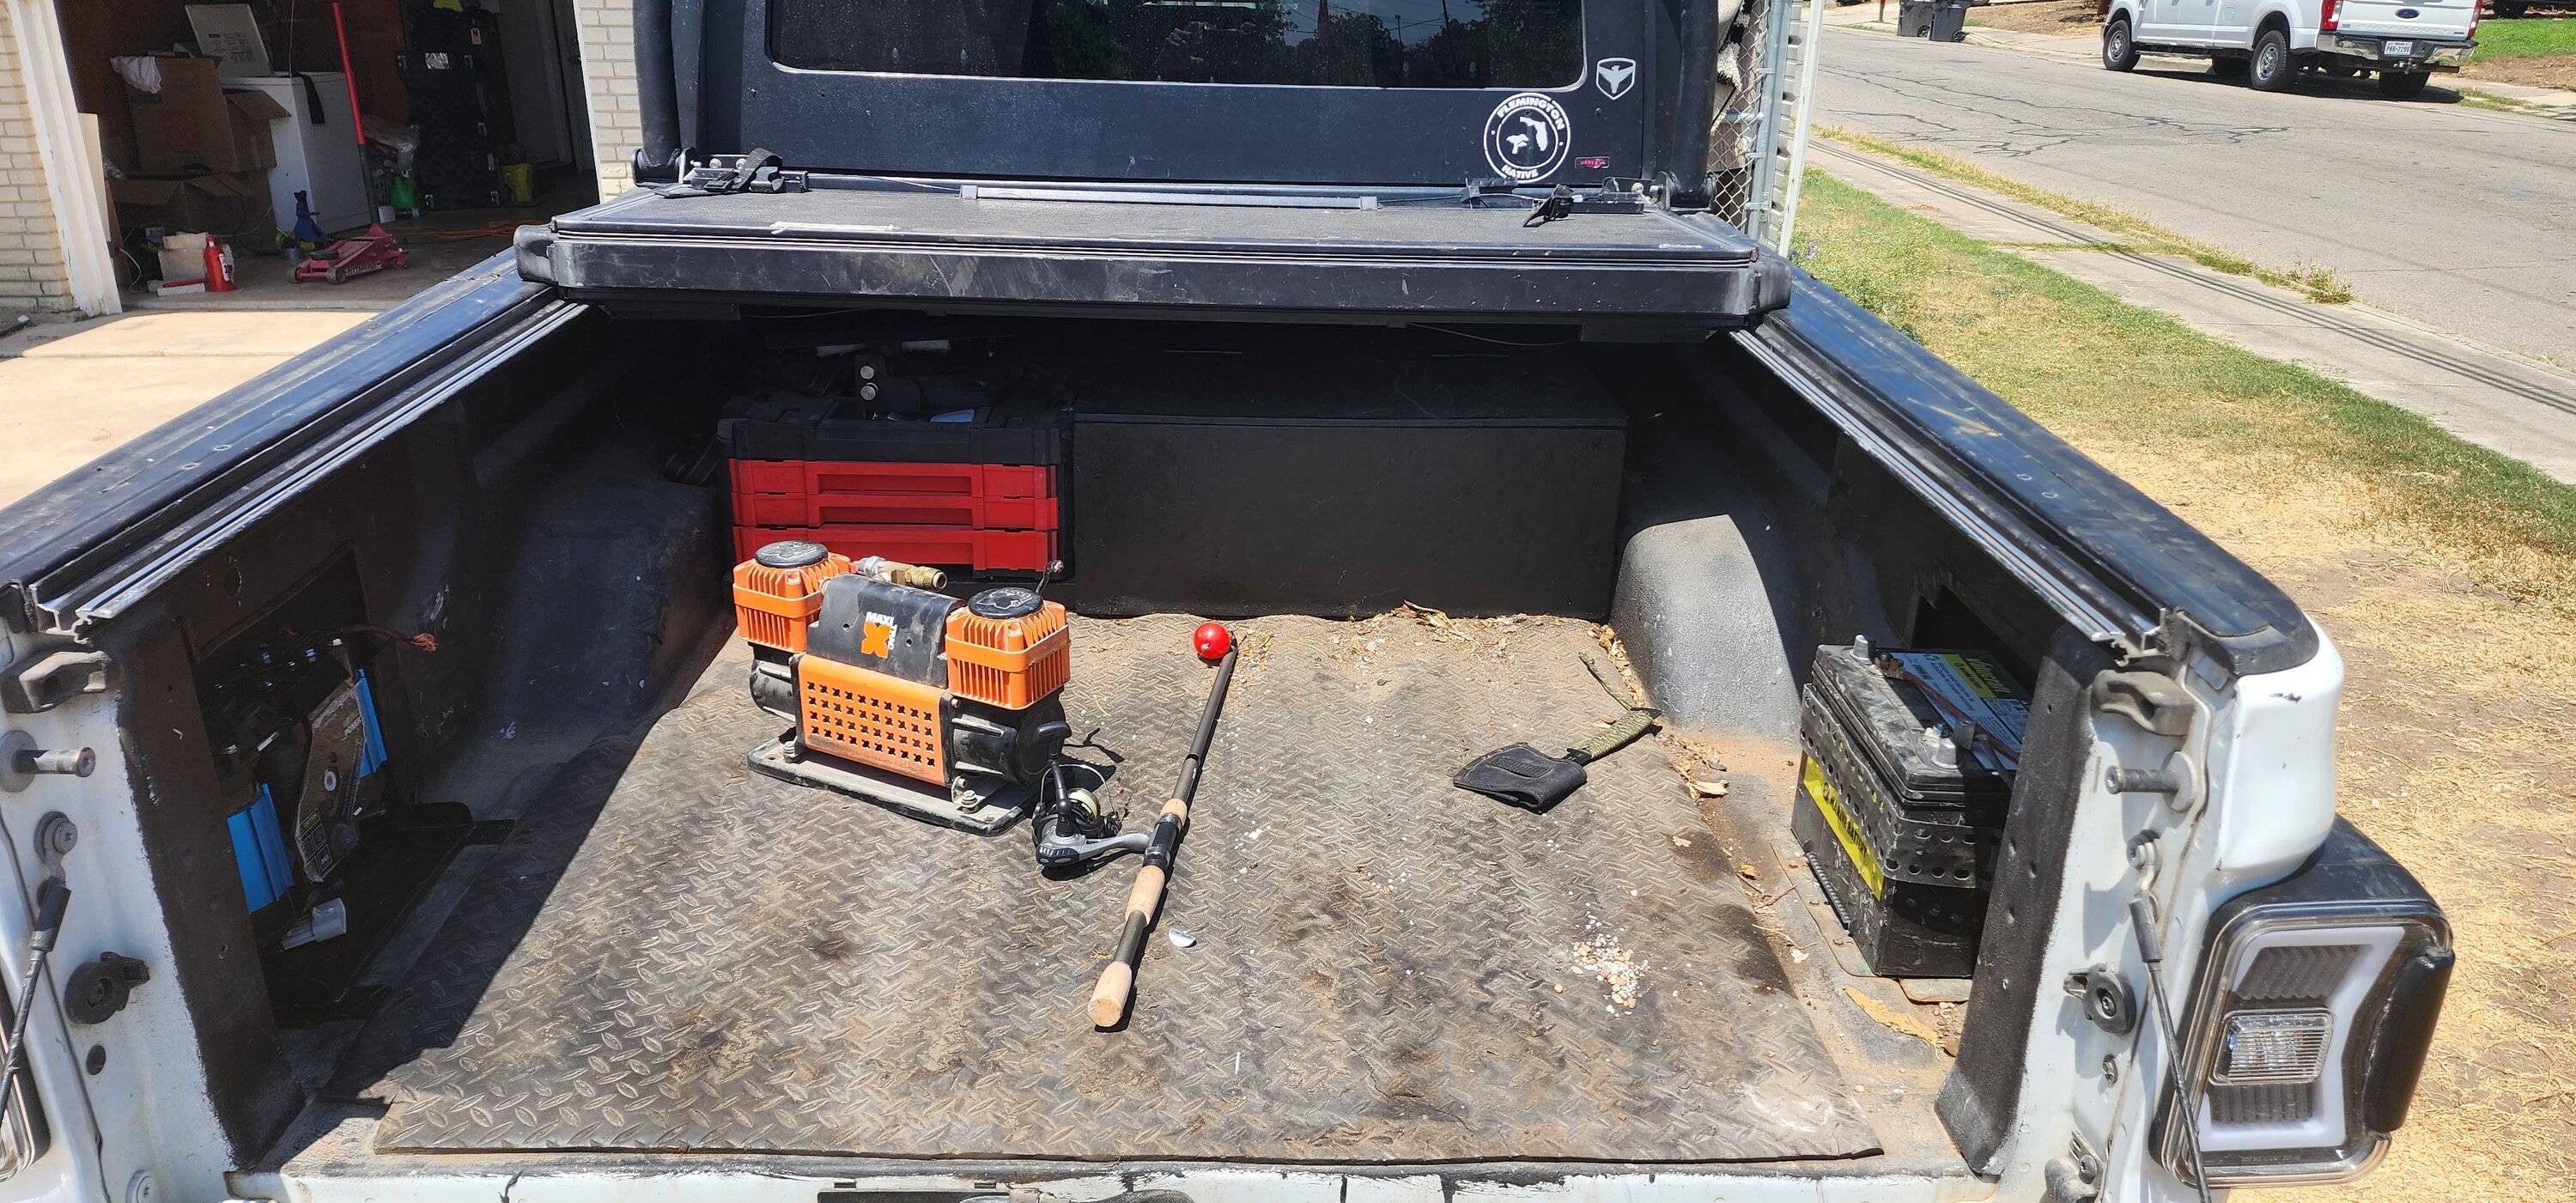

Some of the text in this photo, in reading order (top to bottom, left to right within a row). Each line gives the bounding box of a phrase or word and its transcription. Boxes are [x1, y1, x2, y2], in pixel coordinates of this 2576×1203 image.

[1497, 96, 1565, 131] FLEMINGTON
[1501, 164, 1539, 179] NATIVE
[865, 611, 895, 627] MAXI
[1847, 819, 1868, 858] BATTERY
